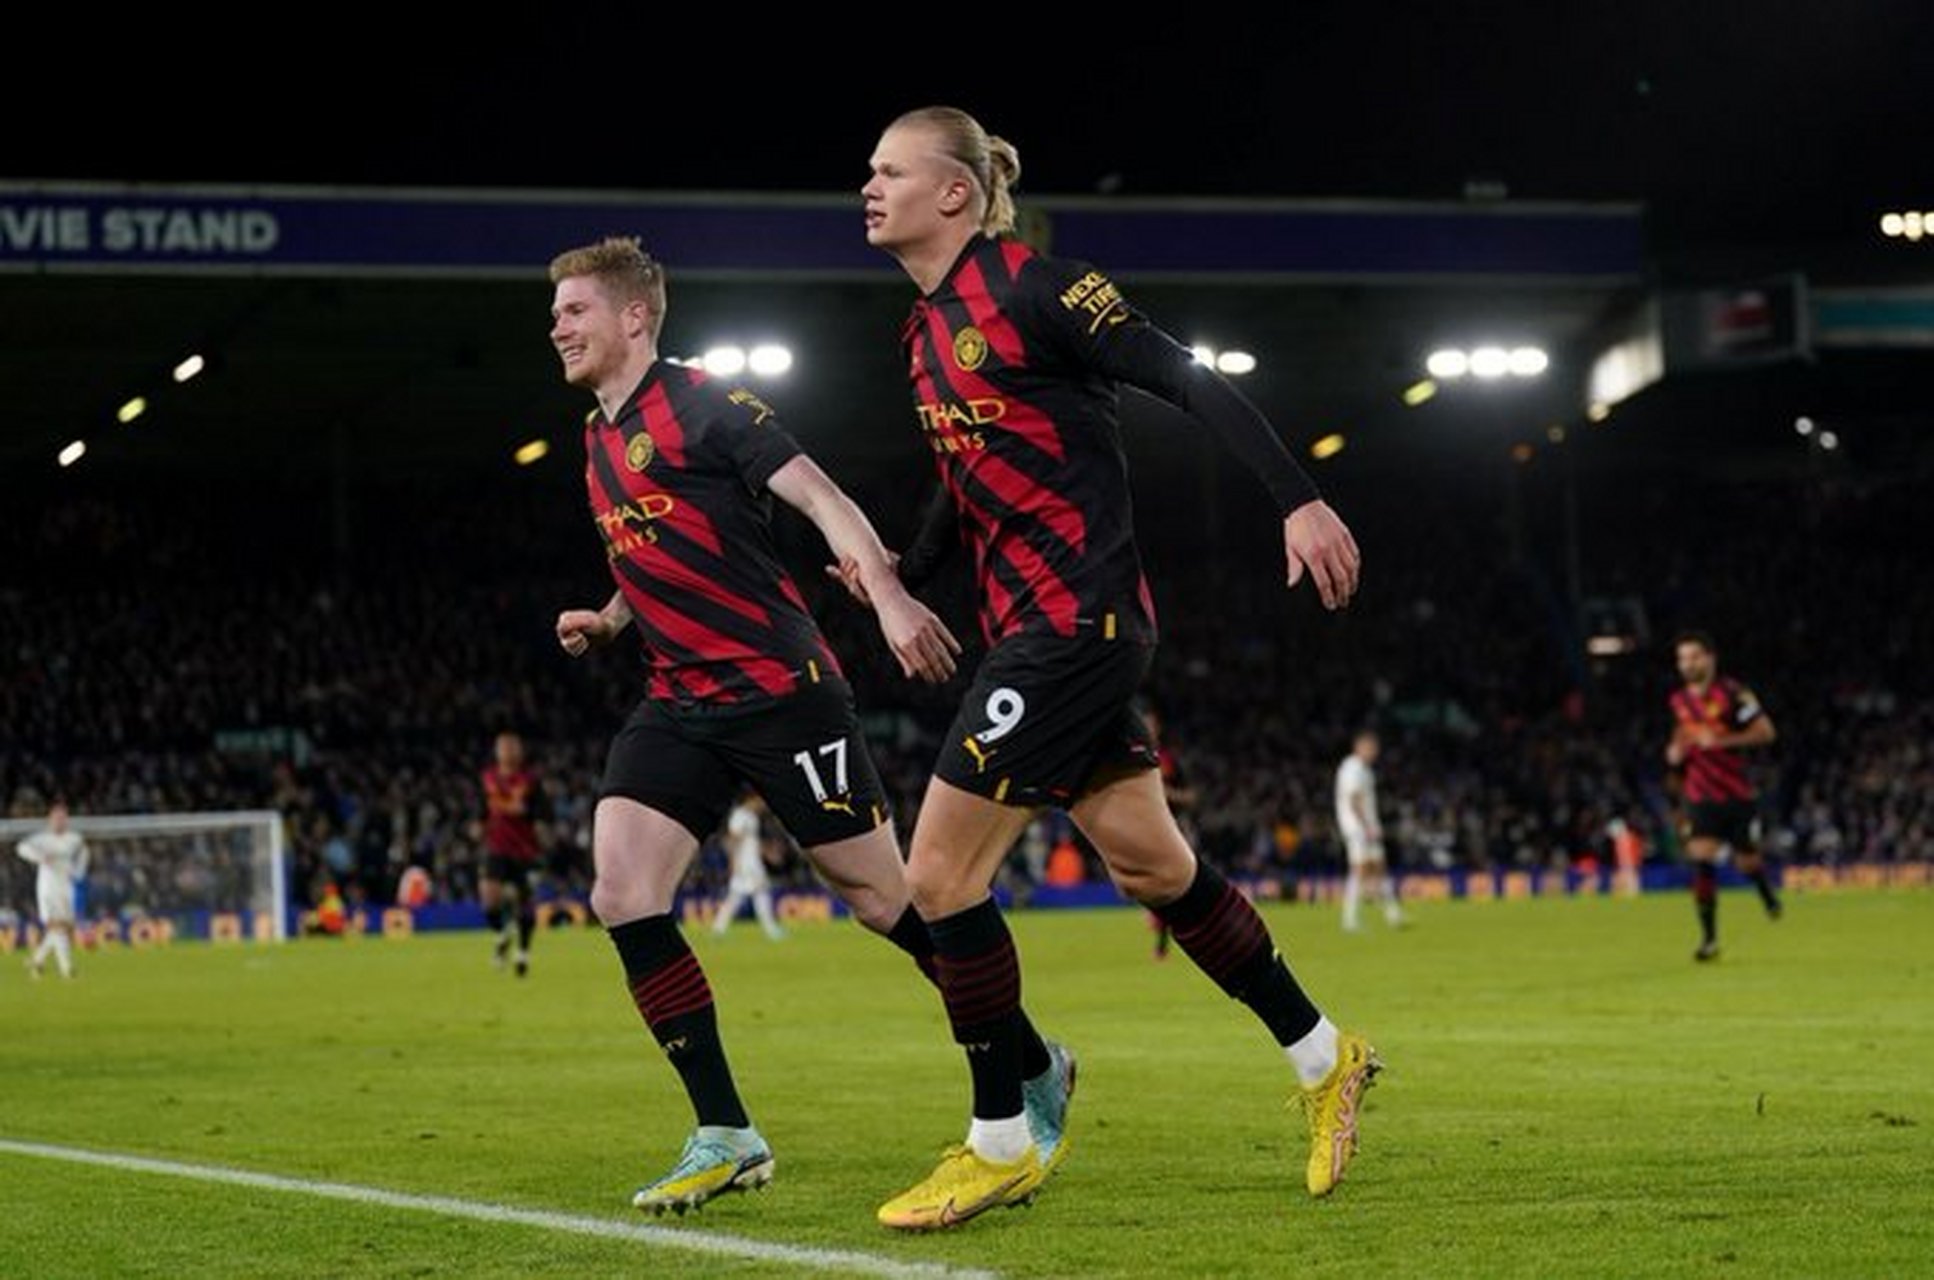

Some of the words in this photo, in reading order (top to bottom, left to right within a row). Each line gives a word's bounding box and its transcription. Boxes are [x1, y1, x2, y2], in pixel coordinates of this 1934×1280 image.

[0, 208, 90, 250] VIE
[103, 207, 279, 251] STAND
[976, 687, 1025, 744] 9
[794, 738, 849, 802] 17
